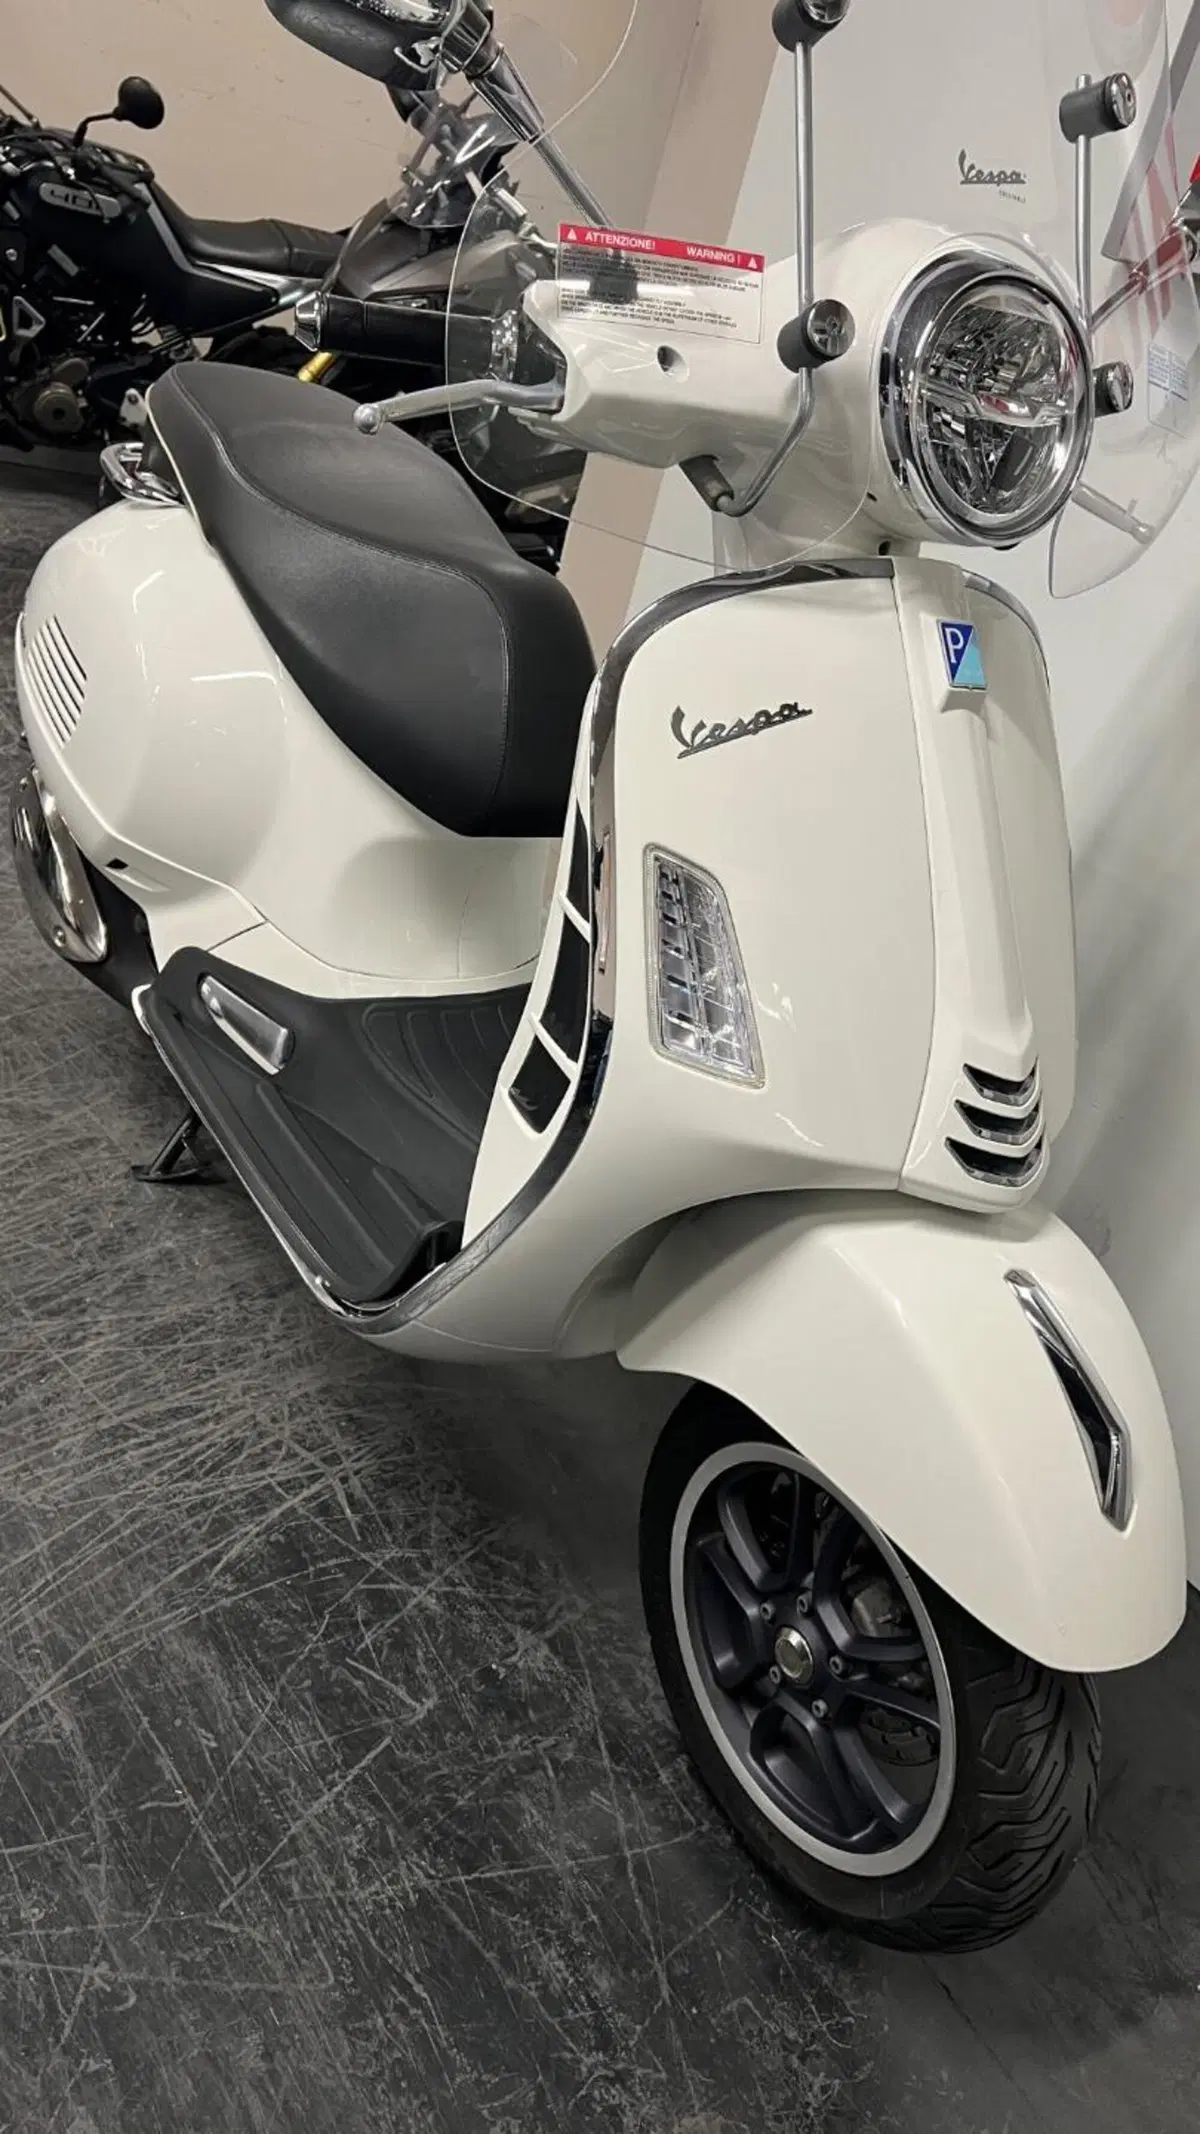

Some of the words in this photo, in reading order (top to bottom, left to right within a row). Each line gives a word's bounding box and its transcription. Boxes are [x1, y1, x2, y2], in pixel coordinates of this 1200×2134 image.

[958, 148, 1027, 187] Vespa
[584, 231, 656, 251] ATTENZIONE!
[944, 627, 964, 663] P
[670, 702, 813, 759] Vespa
